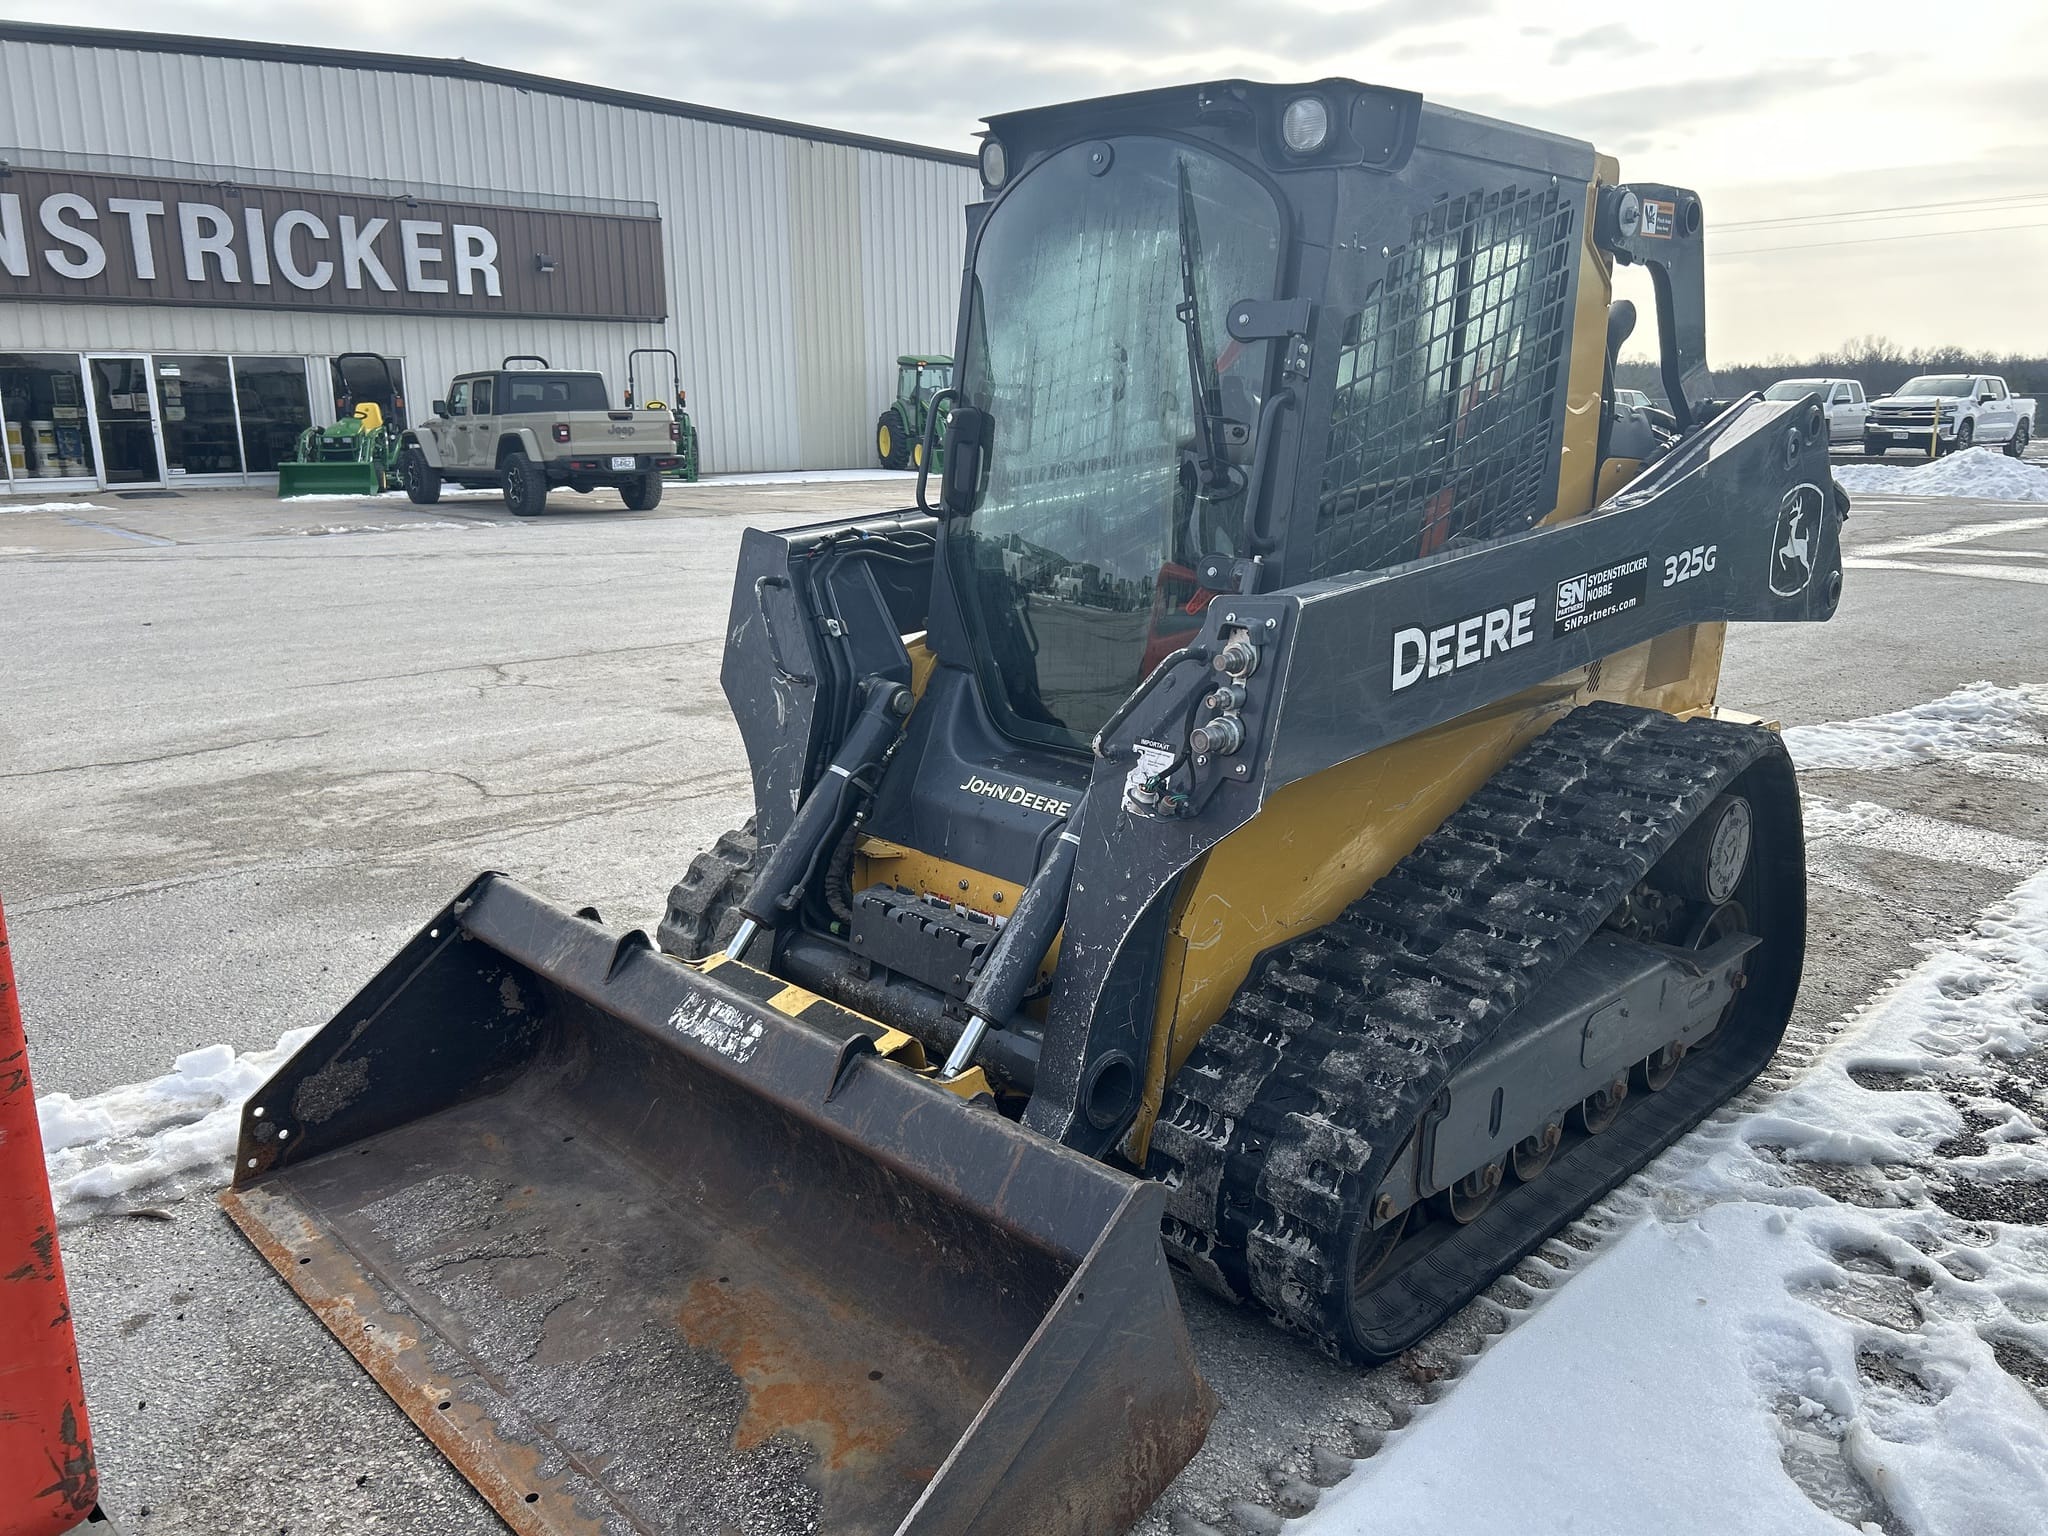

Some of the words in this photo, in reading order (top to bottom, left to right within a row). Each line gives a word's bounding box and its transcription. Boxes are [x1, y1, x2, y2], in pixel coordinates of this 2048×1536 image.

[608, 424, 635, 436] Jeep
[1588, 557, 1648, 587] SYDENSTRICKER
[1663, 545, 1717, 587] 325G
[1559, 578, 1585, 608] SN
[1587, 583, 1613, 602] NOBBE
[1557, 602, 1584, 617] PARTNERS
[1564, 597, 1637, 632] SNPartners.com
[1392, 598, 1536, 692] DEERE
[960, 775, 1009, 800] JOHN
[1008, 786, 1072, 817] DEERE
